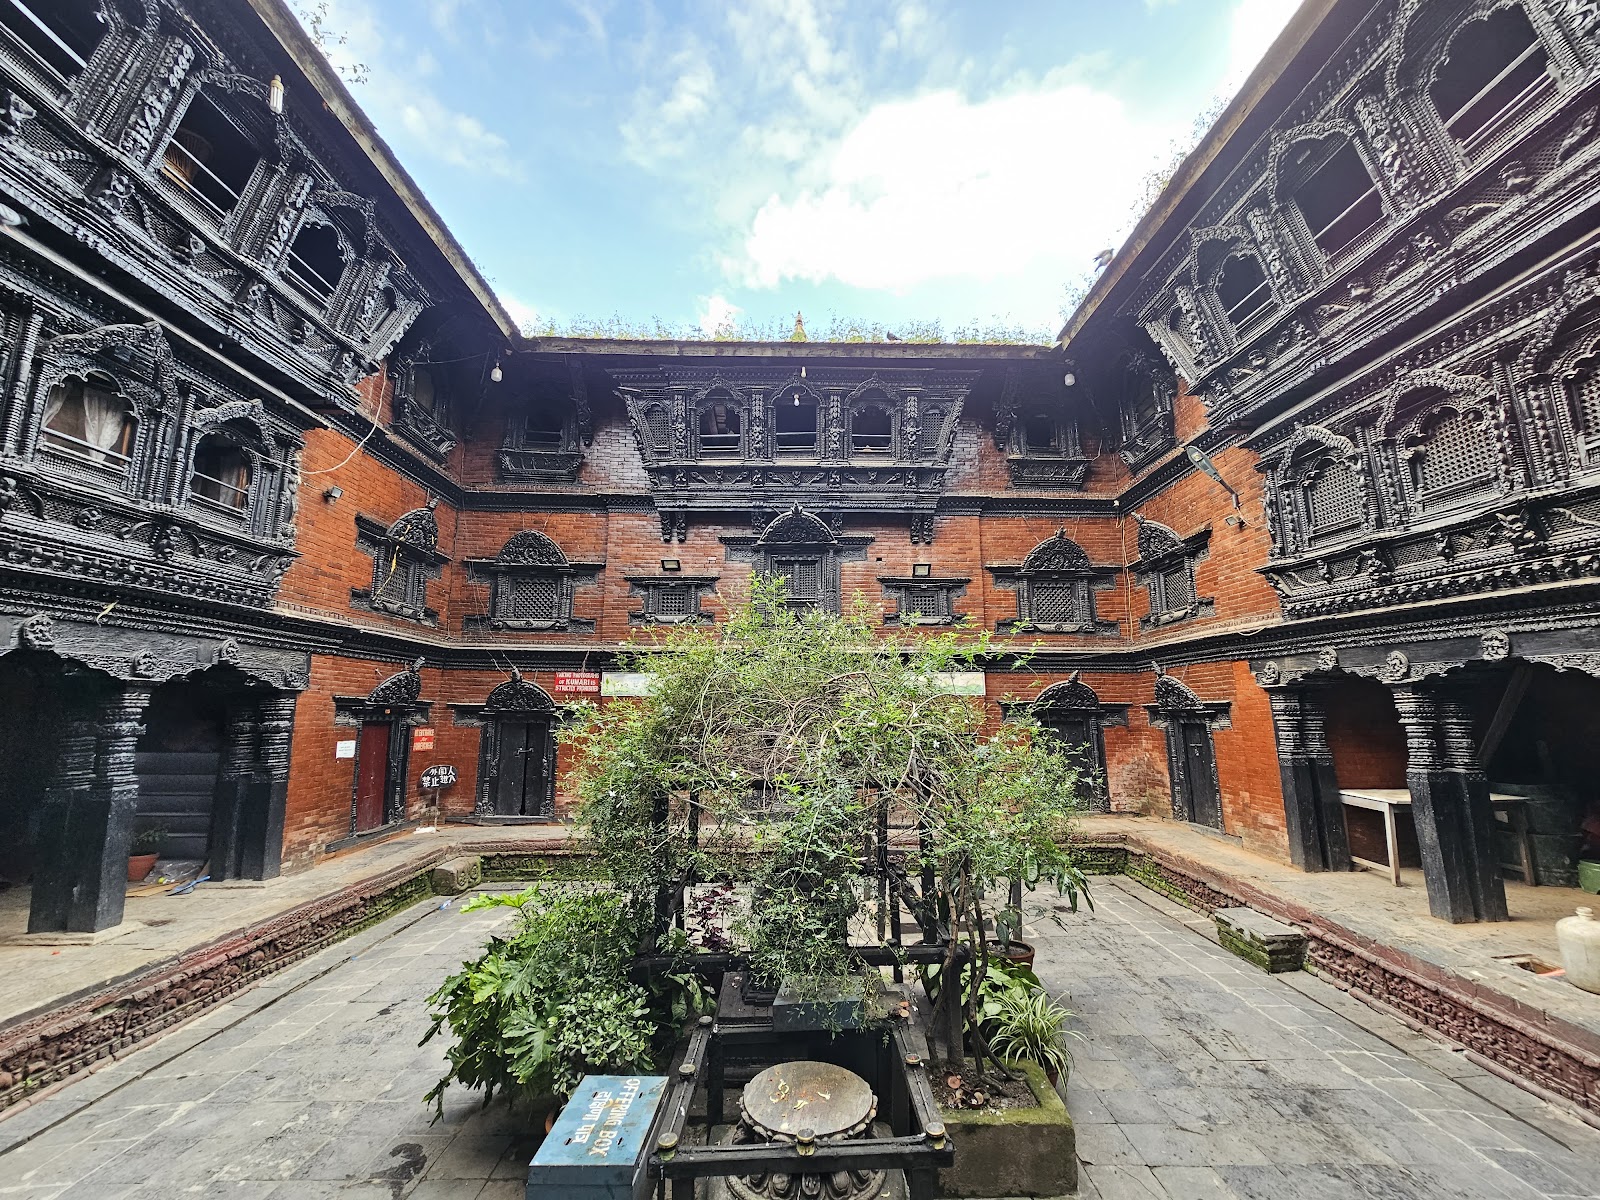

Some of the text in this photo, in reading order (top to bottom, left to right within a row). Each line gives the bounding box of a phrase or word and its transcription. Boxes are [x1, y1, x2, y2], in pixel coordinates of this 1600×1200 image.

[566, 678, 590, 686] KUMARI
[572, 1091, 614, 1144] दक्षिणा पात्र
[588, 1078, 641, 1157] OFFERING BOX
